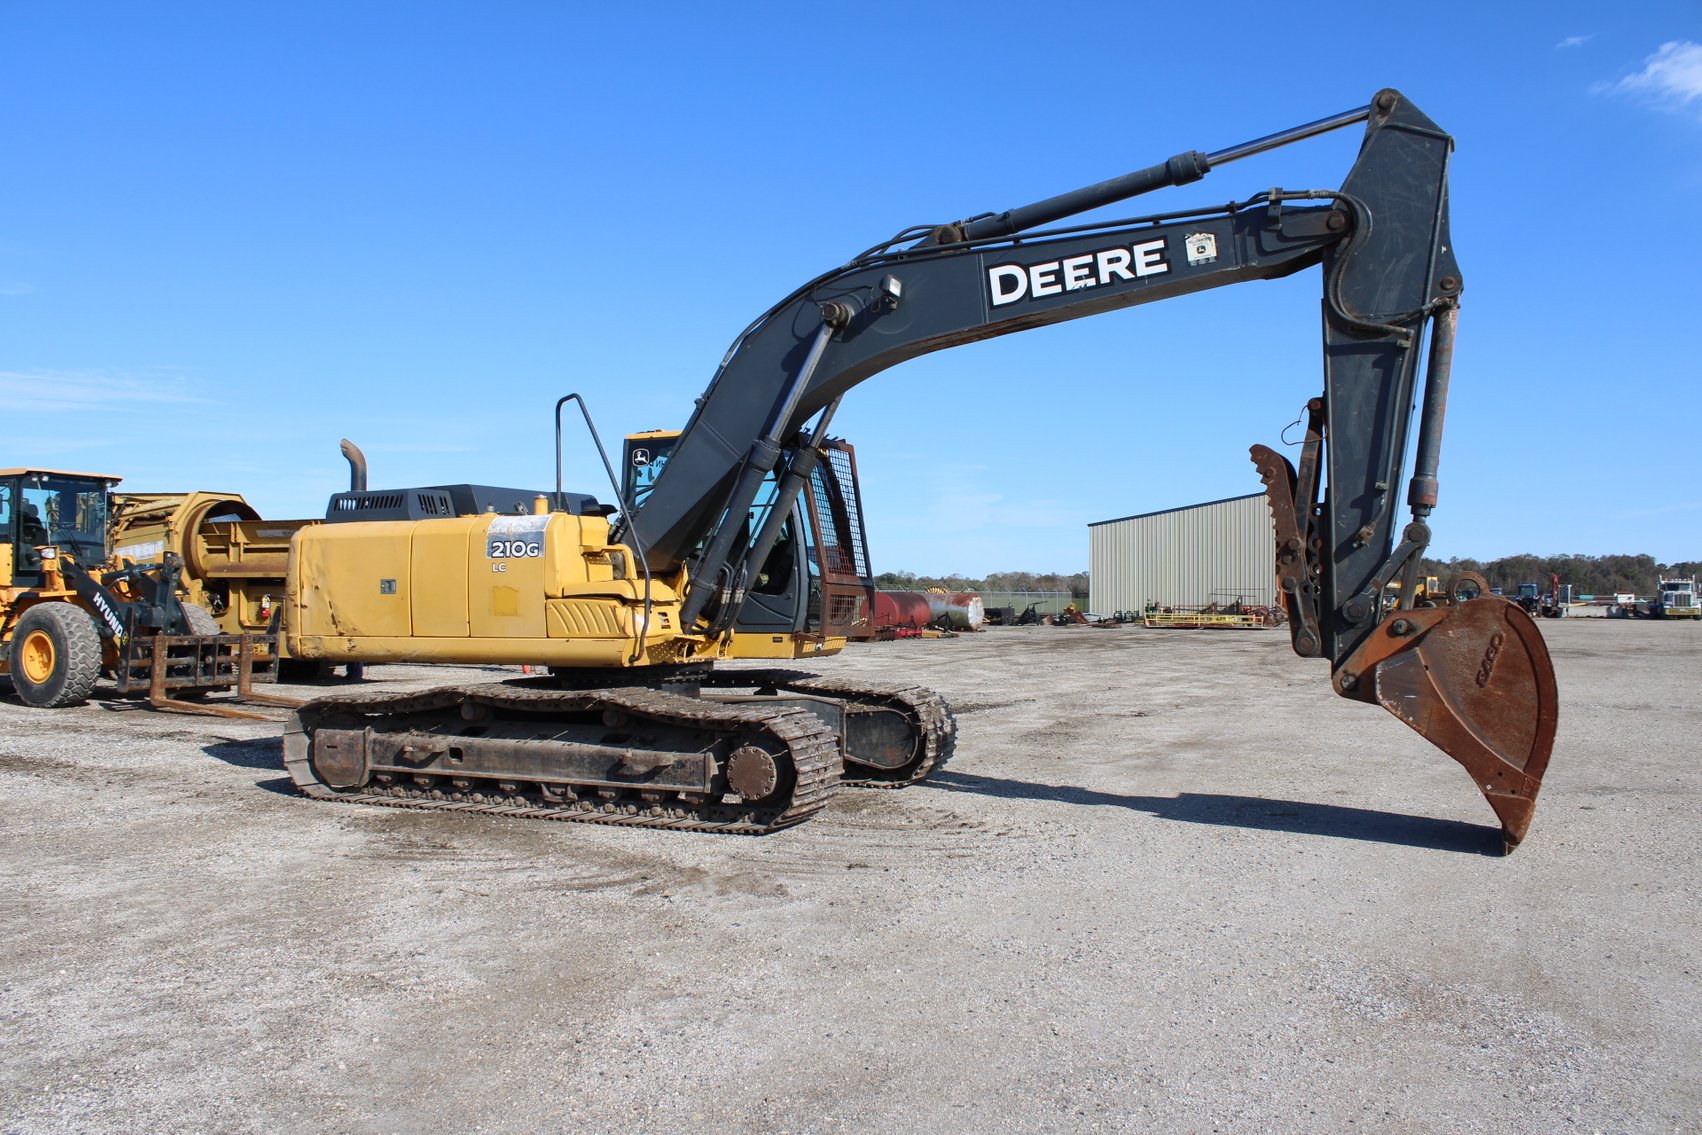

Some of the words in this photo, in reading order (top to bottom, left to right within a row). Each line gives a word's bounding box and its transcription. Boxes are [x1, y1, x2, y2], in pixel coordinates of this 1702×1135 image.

[988, 239, 1168, 306] DEERE
[491, 540, 540, 558] 210G
[492, 562, 506, 572] LC
